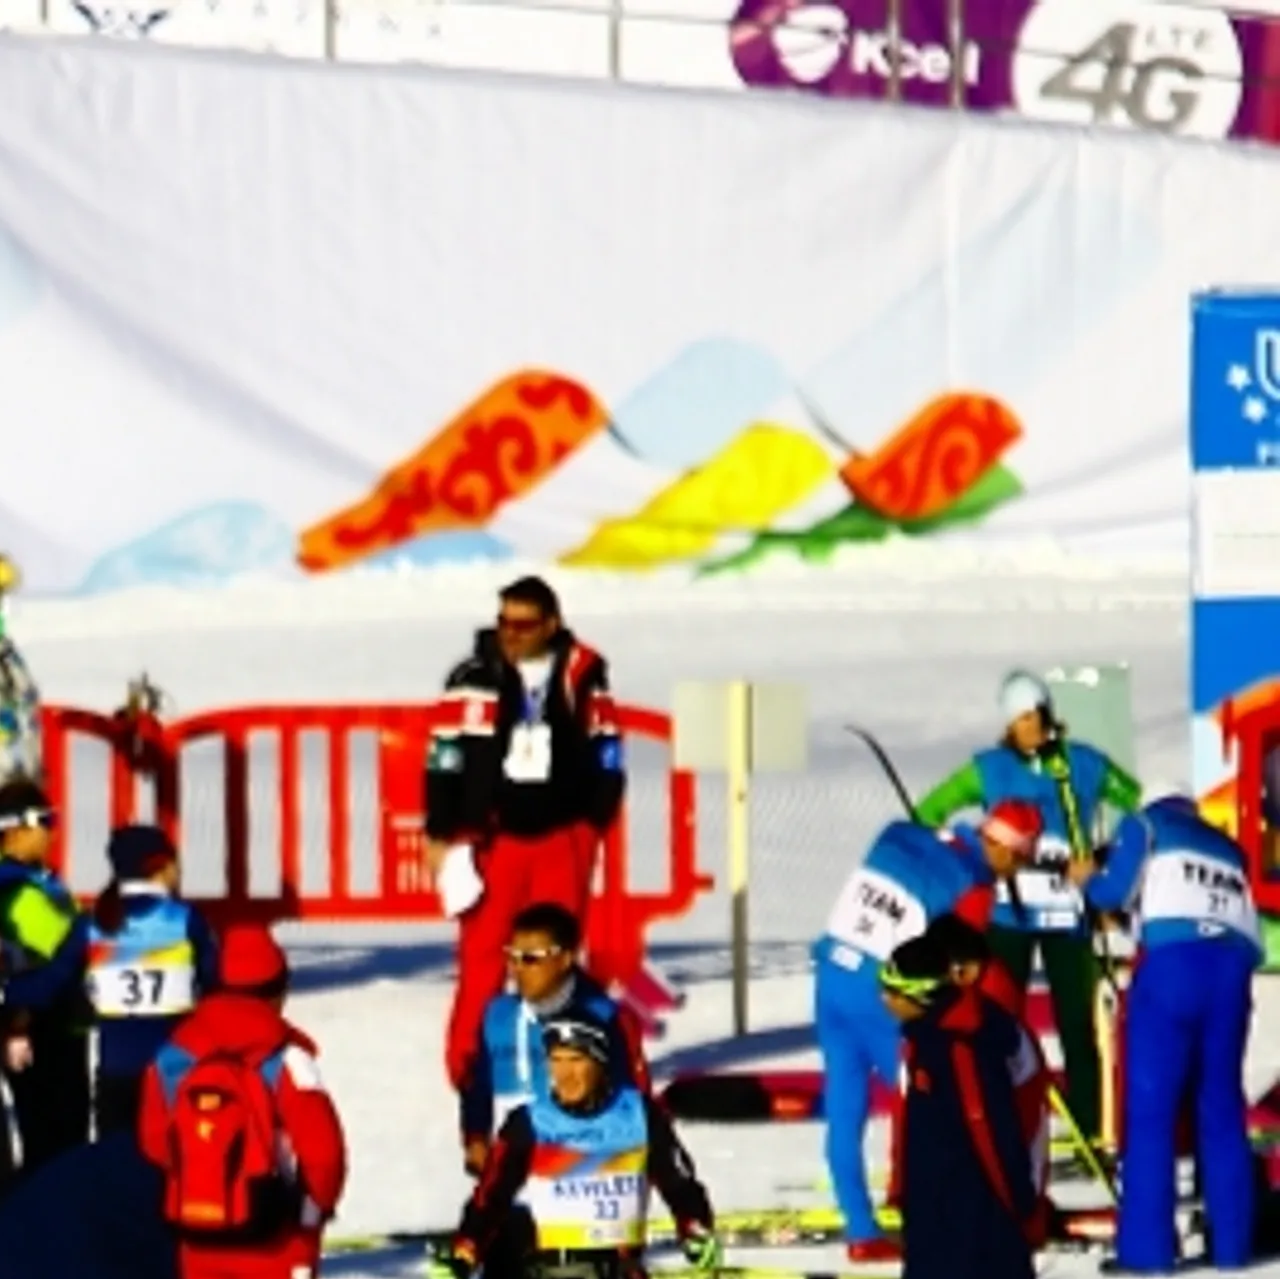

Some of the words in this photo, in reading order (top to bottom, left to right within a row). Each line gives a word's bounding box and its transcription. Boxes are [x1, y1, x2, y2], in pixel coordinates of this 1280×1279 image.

[852, 30, 980, 84] Kcel
[1041, 22, 1205, 126] 4G
[119, 969, 163, 1005] 37
